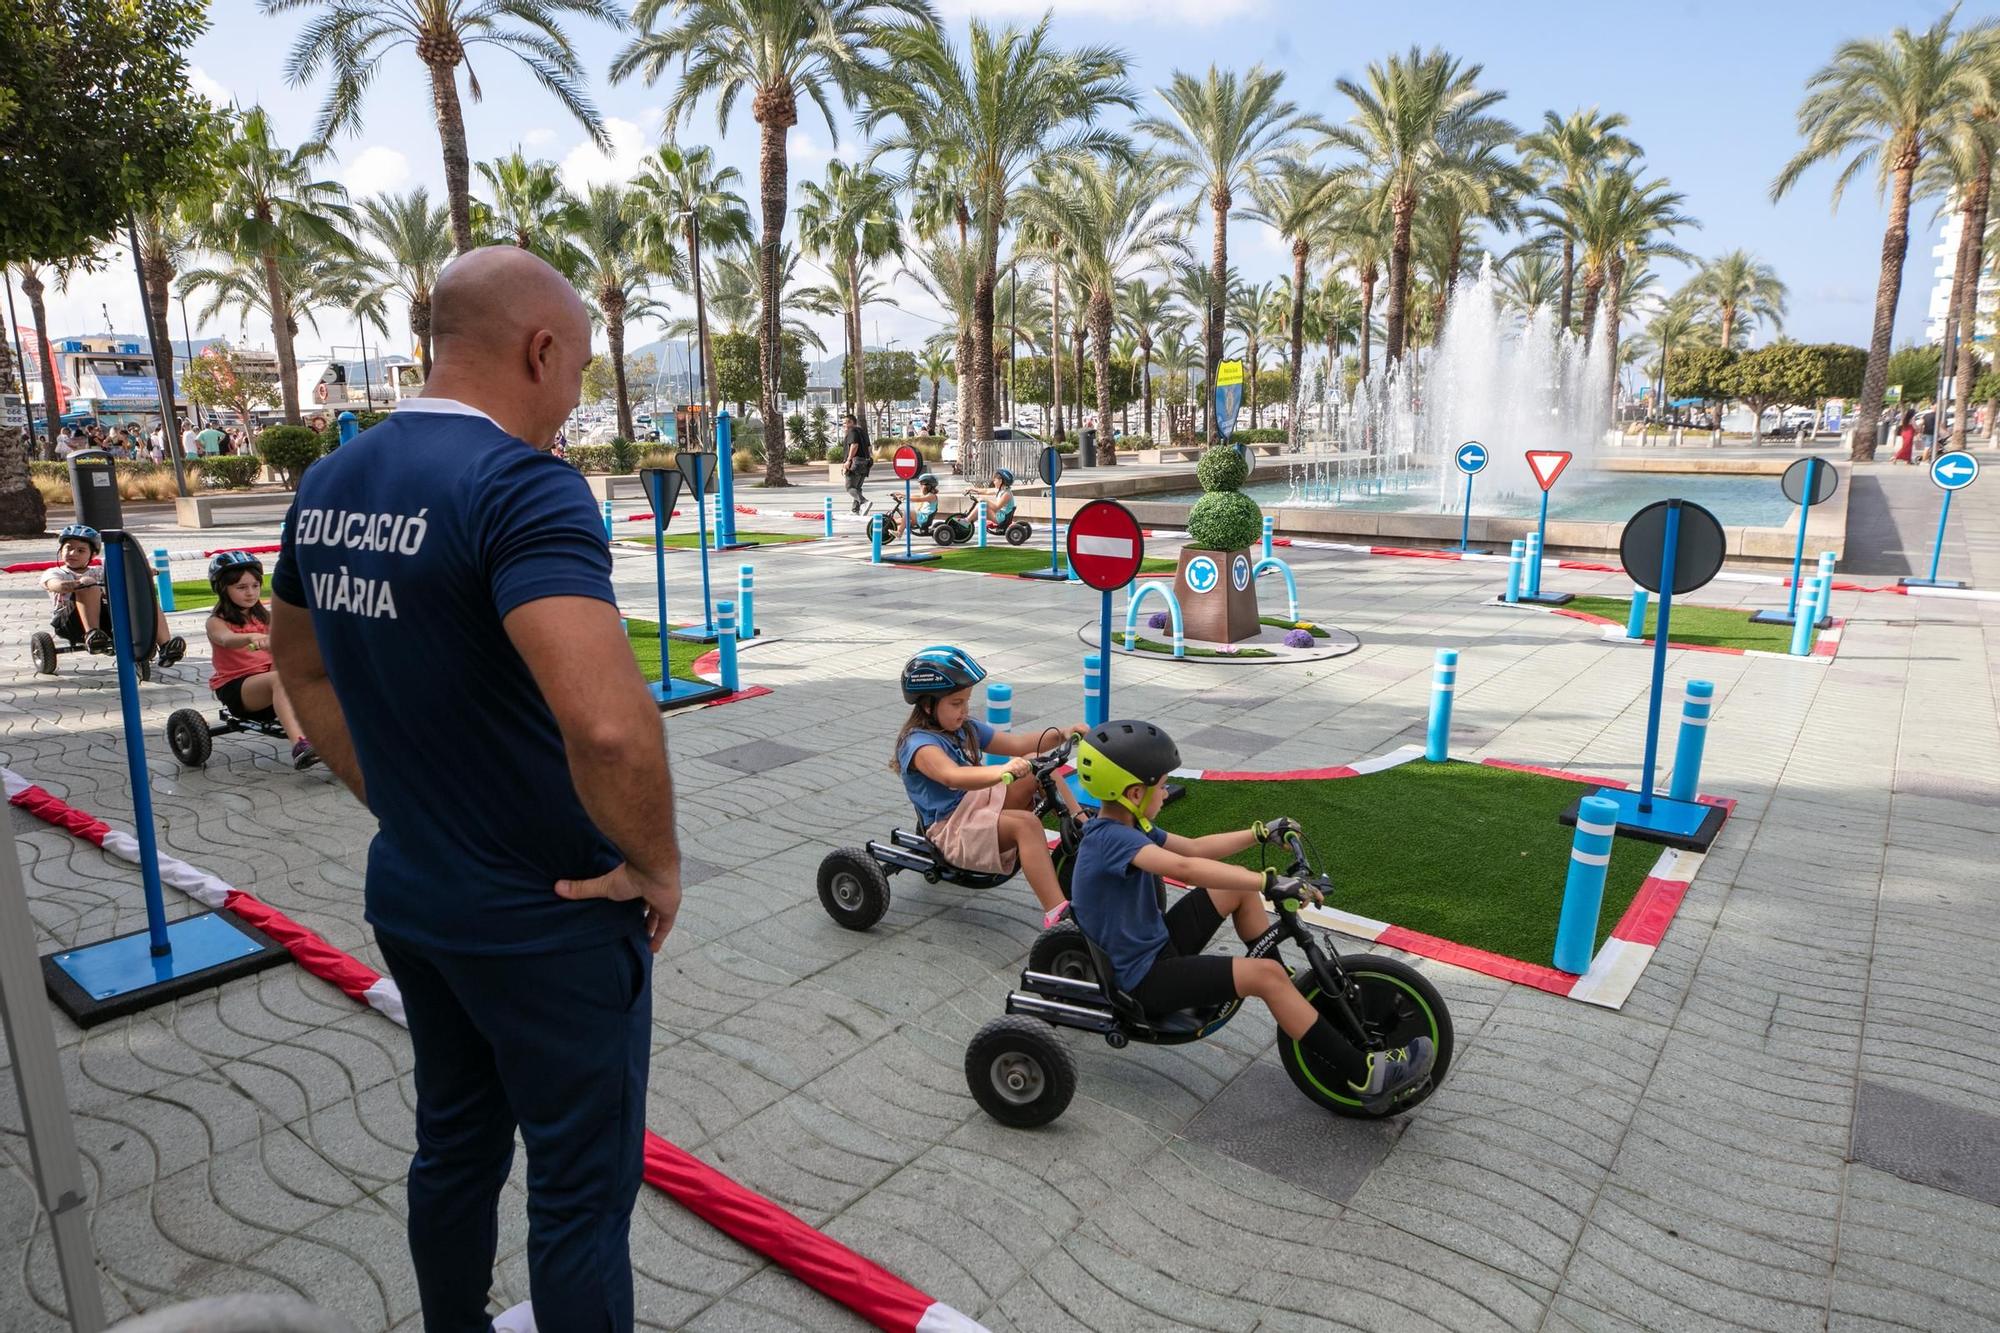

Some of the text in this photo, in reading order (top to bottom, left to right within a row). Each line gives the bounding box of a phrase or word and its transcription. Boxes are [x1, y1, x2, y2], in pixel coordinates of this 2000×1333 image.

[295, 507, 429, 556] EDUCACIÓ
[310, 565, 398, 619] VIÀRIA
[1250, 928, 1279, 959] ORTMANY
